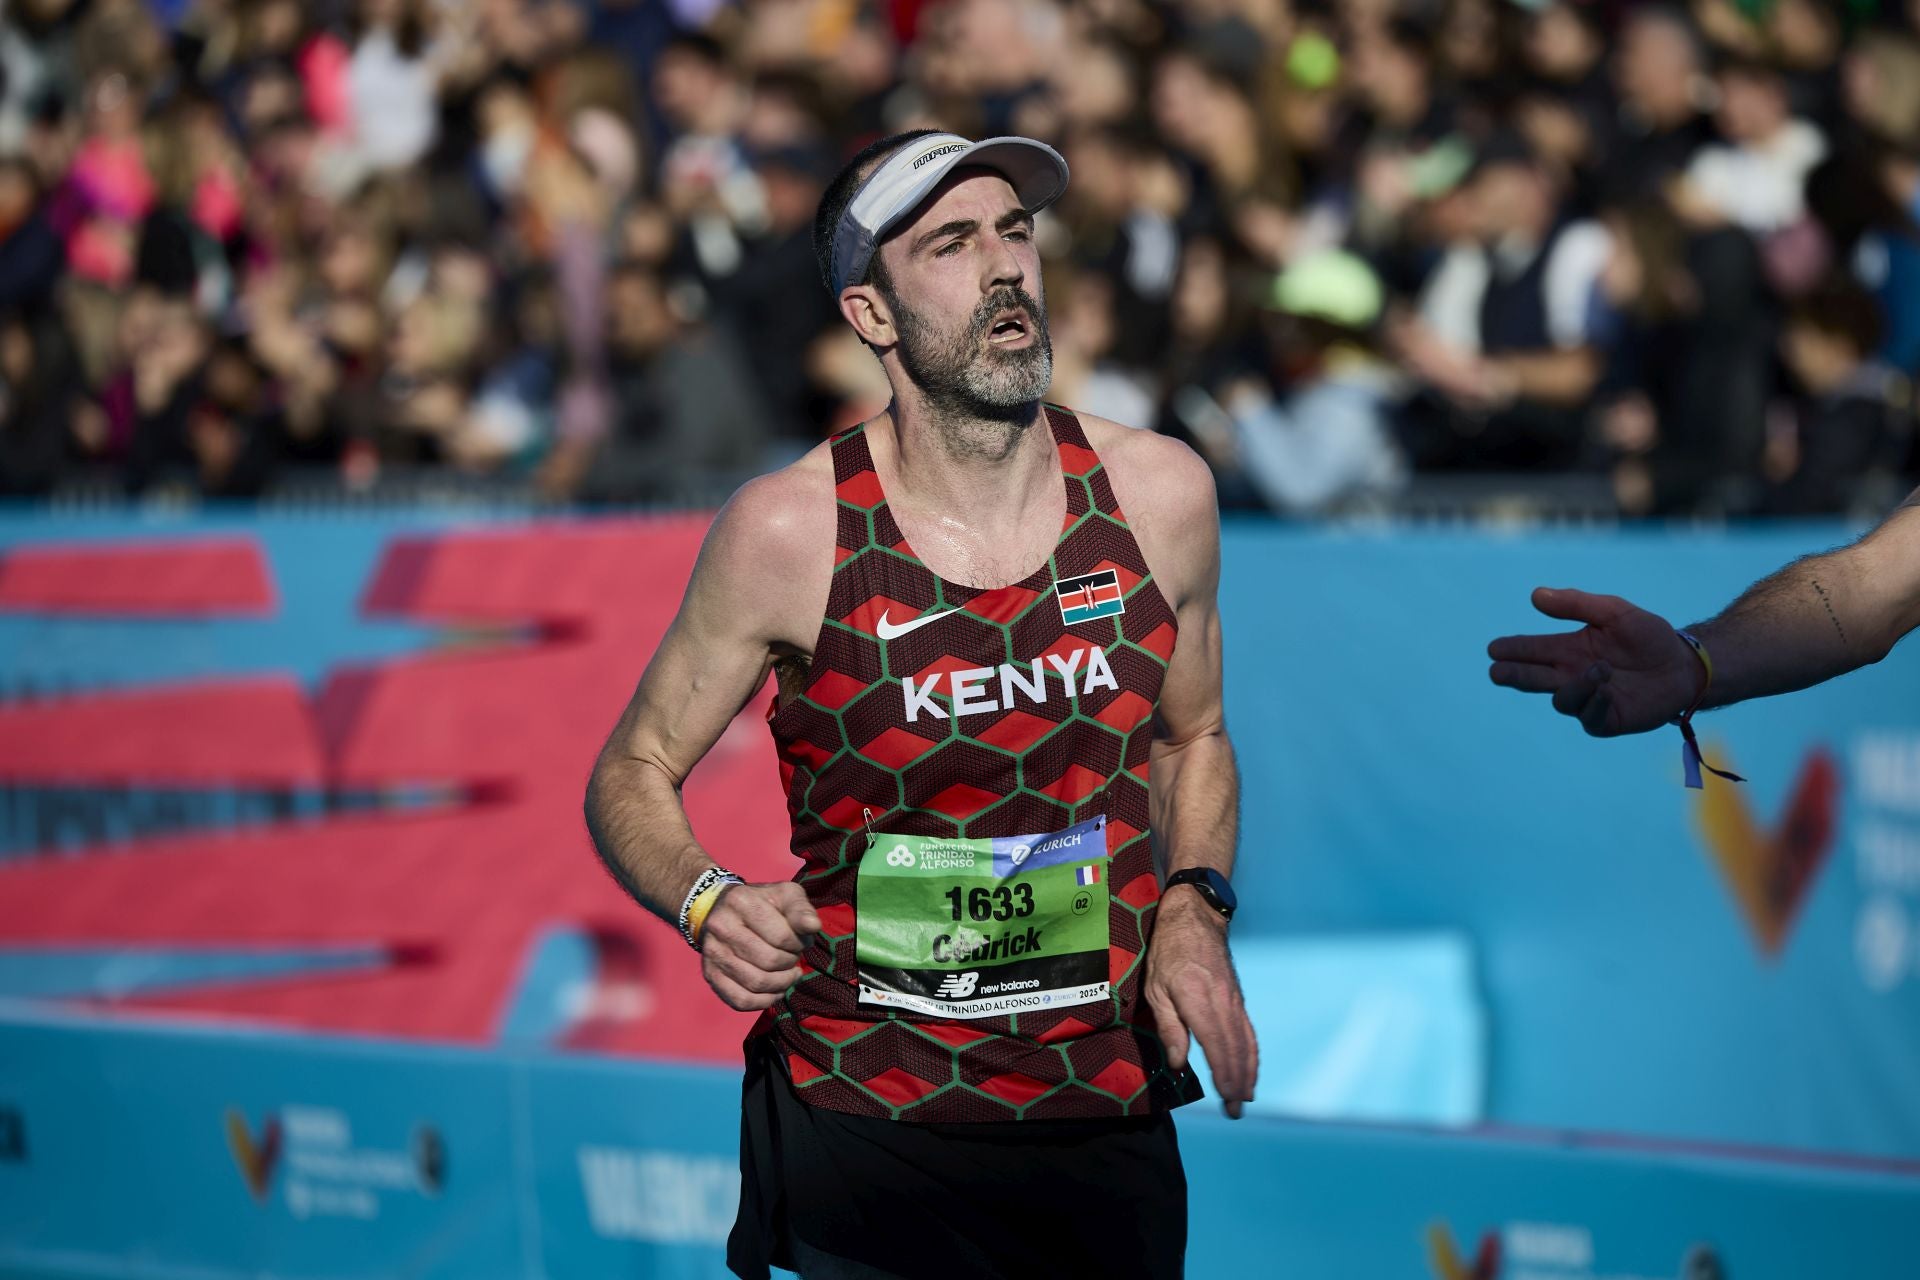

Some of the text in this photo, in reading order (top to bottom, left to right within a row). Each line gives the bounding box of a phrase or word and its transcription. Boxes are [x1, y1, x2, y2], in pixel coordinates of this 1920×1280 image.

[902, 646, 1119, 722] KENYA
[1033, 833, 1081, 855] ZURICH
[920, 851, 975, 861] TRINIDAD
[920, 859, 975, 870] ALFONSO
[945, 882, 1035, 922] 1633
[1075, 898, 1089, 910] 02
[980, 979, 1040, 995] new balance
[945, 1002, 992, 1014] TRINIDAD
[993, 996, 1040, 1011] ALFONSO
[1079, 988, 1099, 999] 2025
